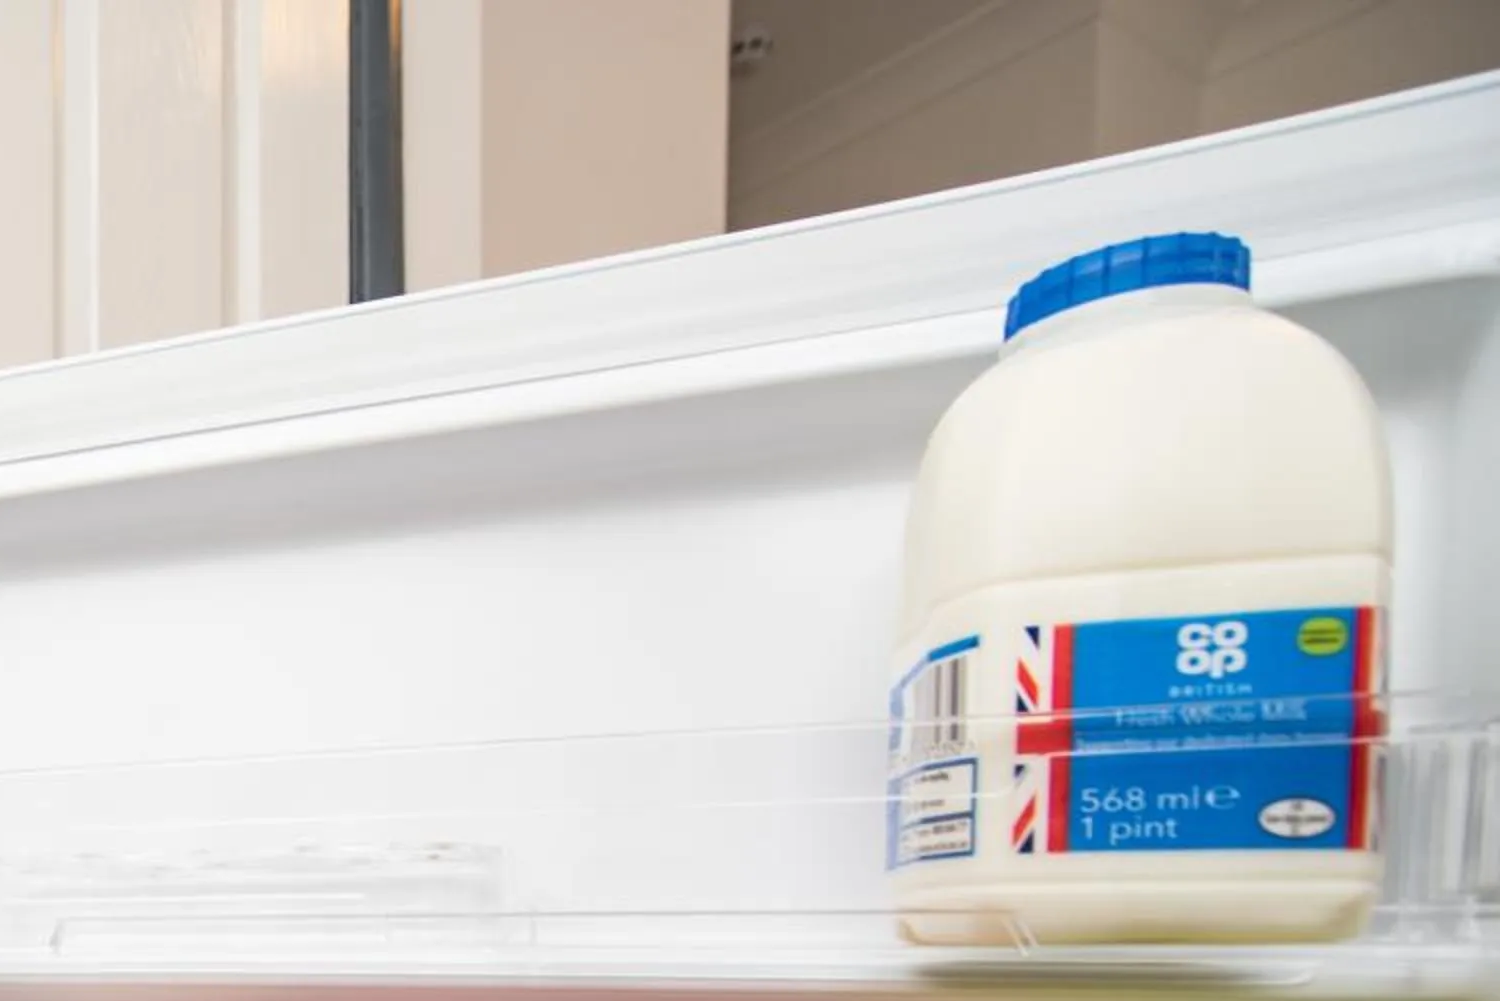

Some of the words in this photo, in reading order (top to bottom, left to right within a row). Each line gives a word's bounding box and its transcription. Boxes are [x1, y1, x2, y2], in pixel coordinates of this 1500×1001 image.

[1080, 787, 1146, 813] 568
[1156, 784, 1200, 811] ml
[1080, 816, 1093, 841] 1
[1109, 814, 1178, 846] pint
